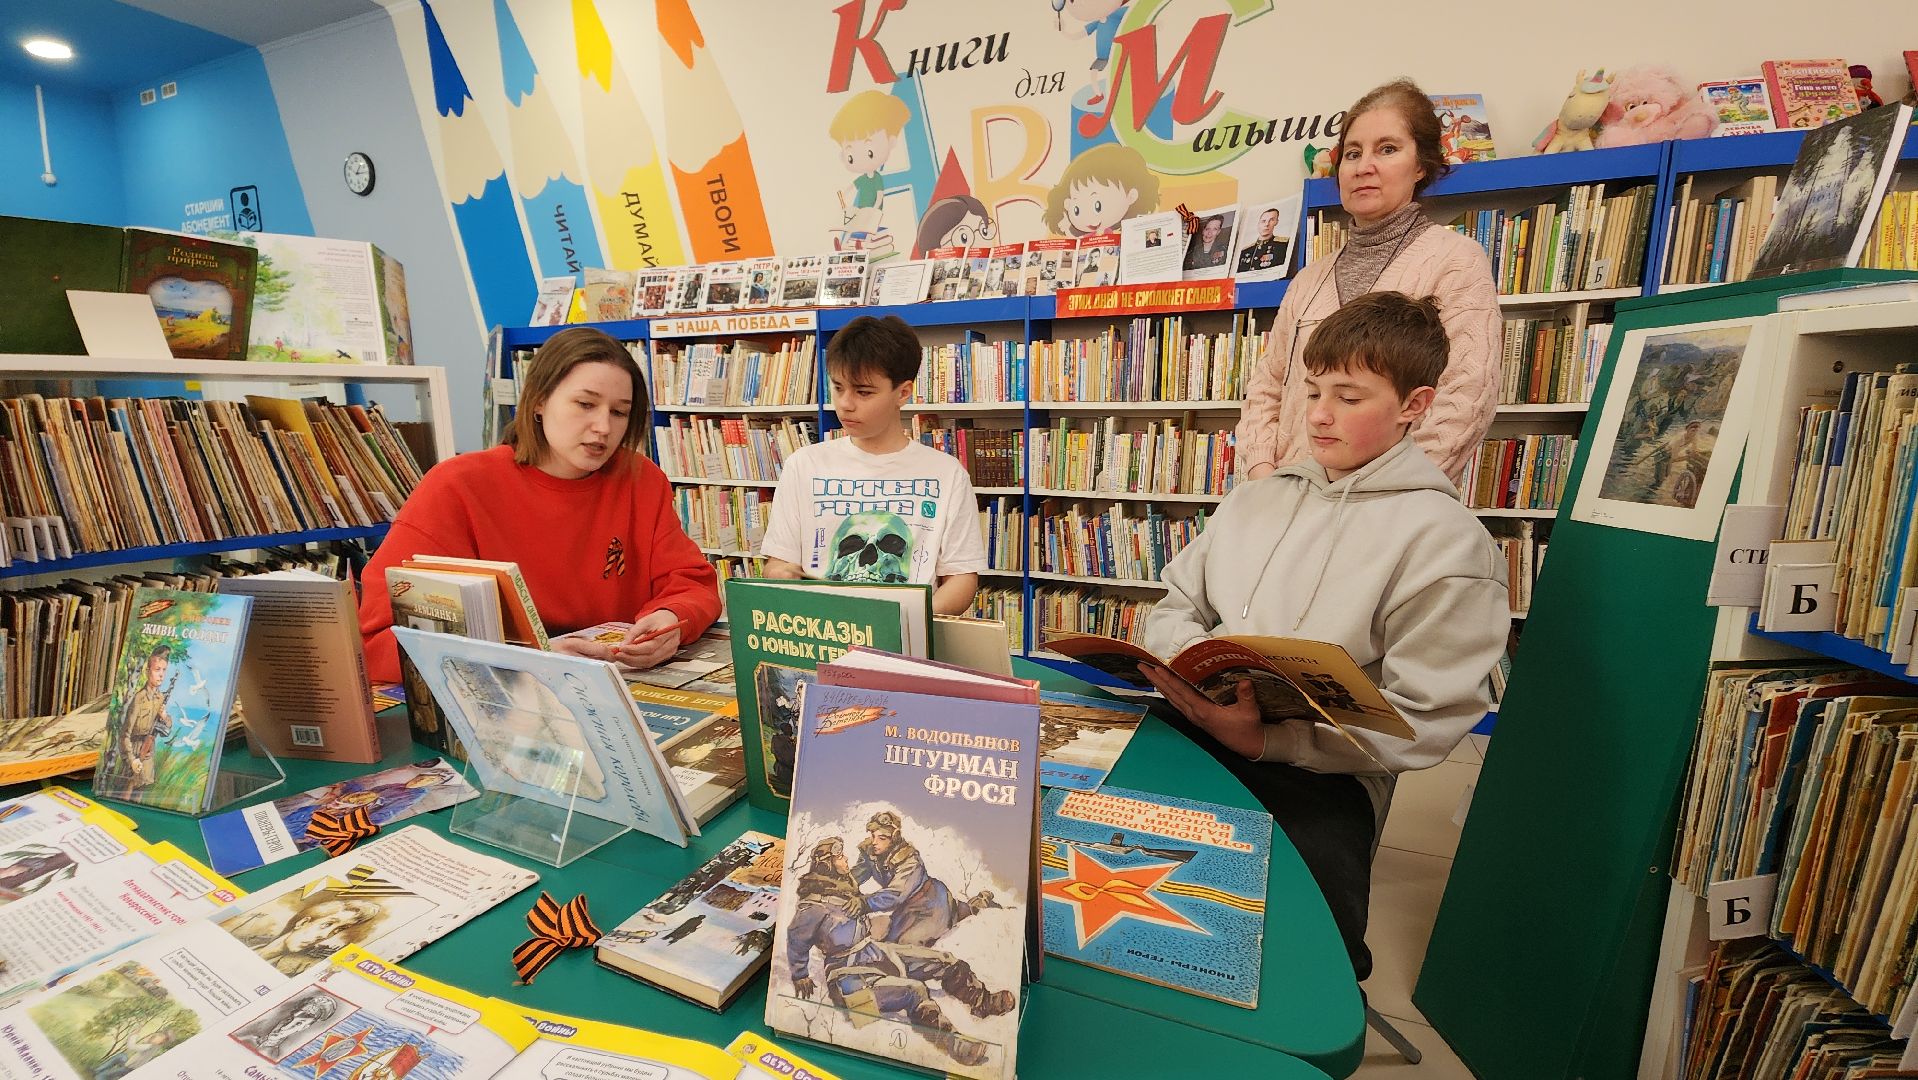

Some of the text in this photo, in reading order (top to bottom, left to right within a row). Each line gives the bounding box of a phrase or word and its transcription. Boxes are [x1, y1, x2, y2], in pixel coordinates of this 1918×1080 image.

[1014, 68, 1066, 99] для
[1077, 13, 1345, 154] Малыше
[185, 199, 225, 216] СТАРШИЙ
[706, 174, 741, 254] ТВОРИ
[181, 215, 230, 233] АБОНЕМЕНТ
[622, 191, 659, 268] ДУМАЙ
[553, 204, 583, 273] ЧИТАЙ
[168, 255, 218, 267] природа
[173, 247, 215, 261] Родная
[1594, 266, 1603, 284] Б
[1068, 285, 1221, 310] ЭТИХ ДНЕЙ НЕ СМОЛКНЕТ СЛАВА
[676, 315, 791, 334] НАША ПОБЕДА
[812, 478, 941, 498] INTER
[412, 603, 459, 623] ЗЕМЛЯНКА
[1786, 583, 1819, 615] Б
[142, 623, 229, 644] ЖИВИ, СОЛДАТ
[752, 609, 874, 647] РАССКАЗЫ
[748, 634, 850, 662] О ЮНЫХ ГЕР
[563, 671, 649, 825] Снежная королева
[884, 725, 1021, 752] М. ВОДОПЬЯНОВ
[884, 744, 1019, 780] ШТУРМАН
[924, 774, 1017, 806] ФРОСЯ
[1065, 803, 1230, 840] ВАЛЕРИЙ ВОЛКОВ
[1068, 796, 1231, 831] ВОЛОДЯ ДУБИНИН
[1173, 808, 1215, 821] ВИТЯ
[1060, 809, 1252, 851] ЮТА БОНДАРОВСКАЯ
[1722, 896, 1751, 927] Б
[536, 1020, 577, 1038] ВОЙНЫ
[760, 1052, 794, 1074] ДЕТИ
